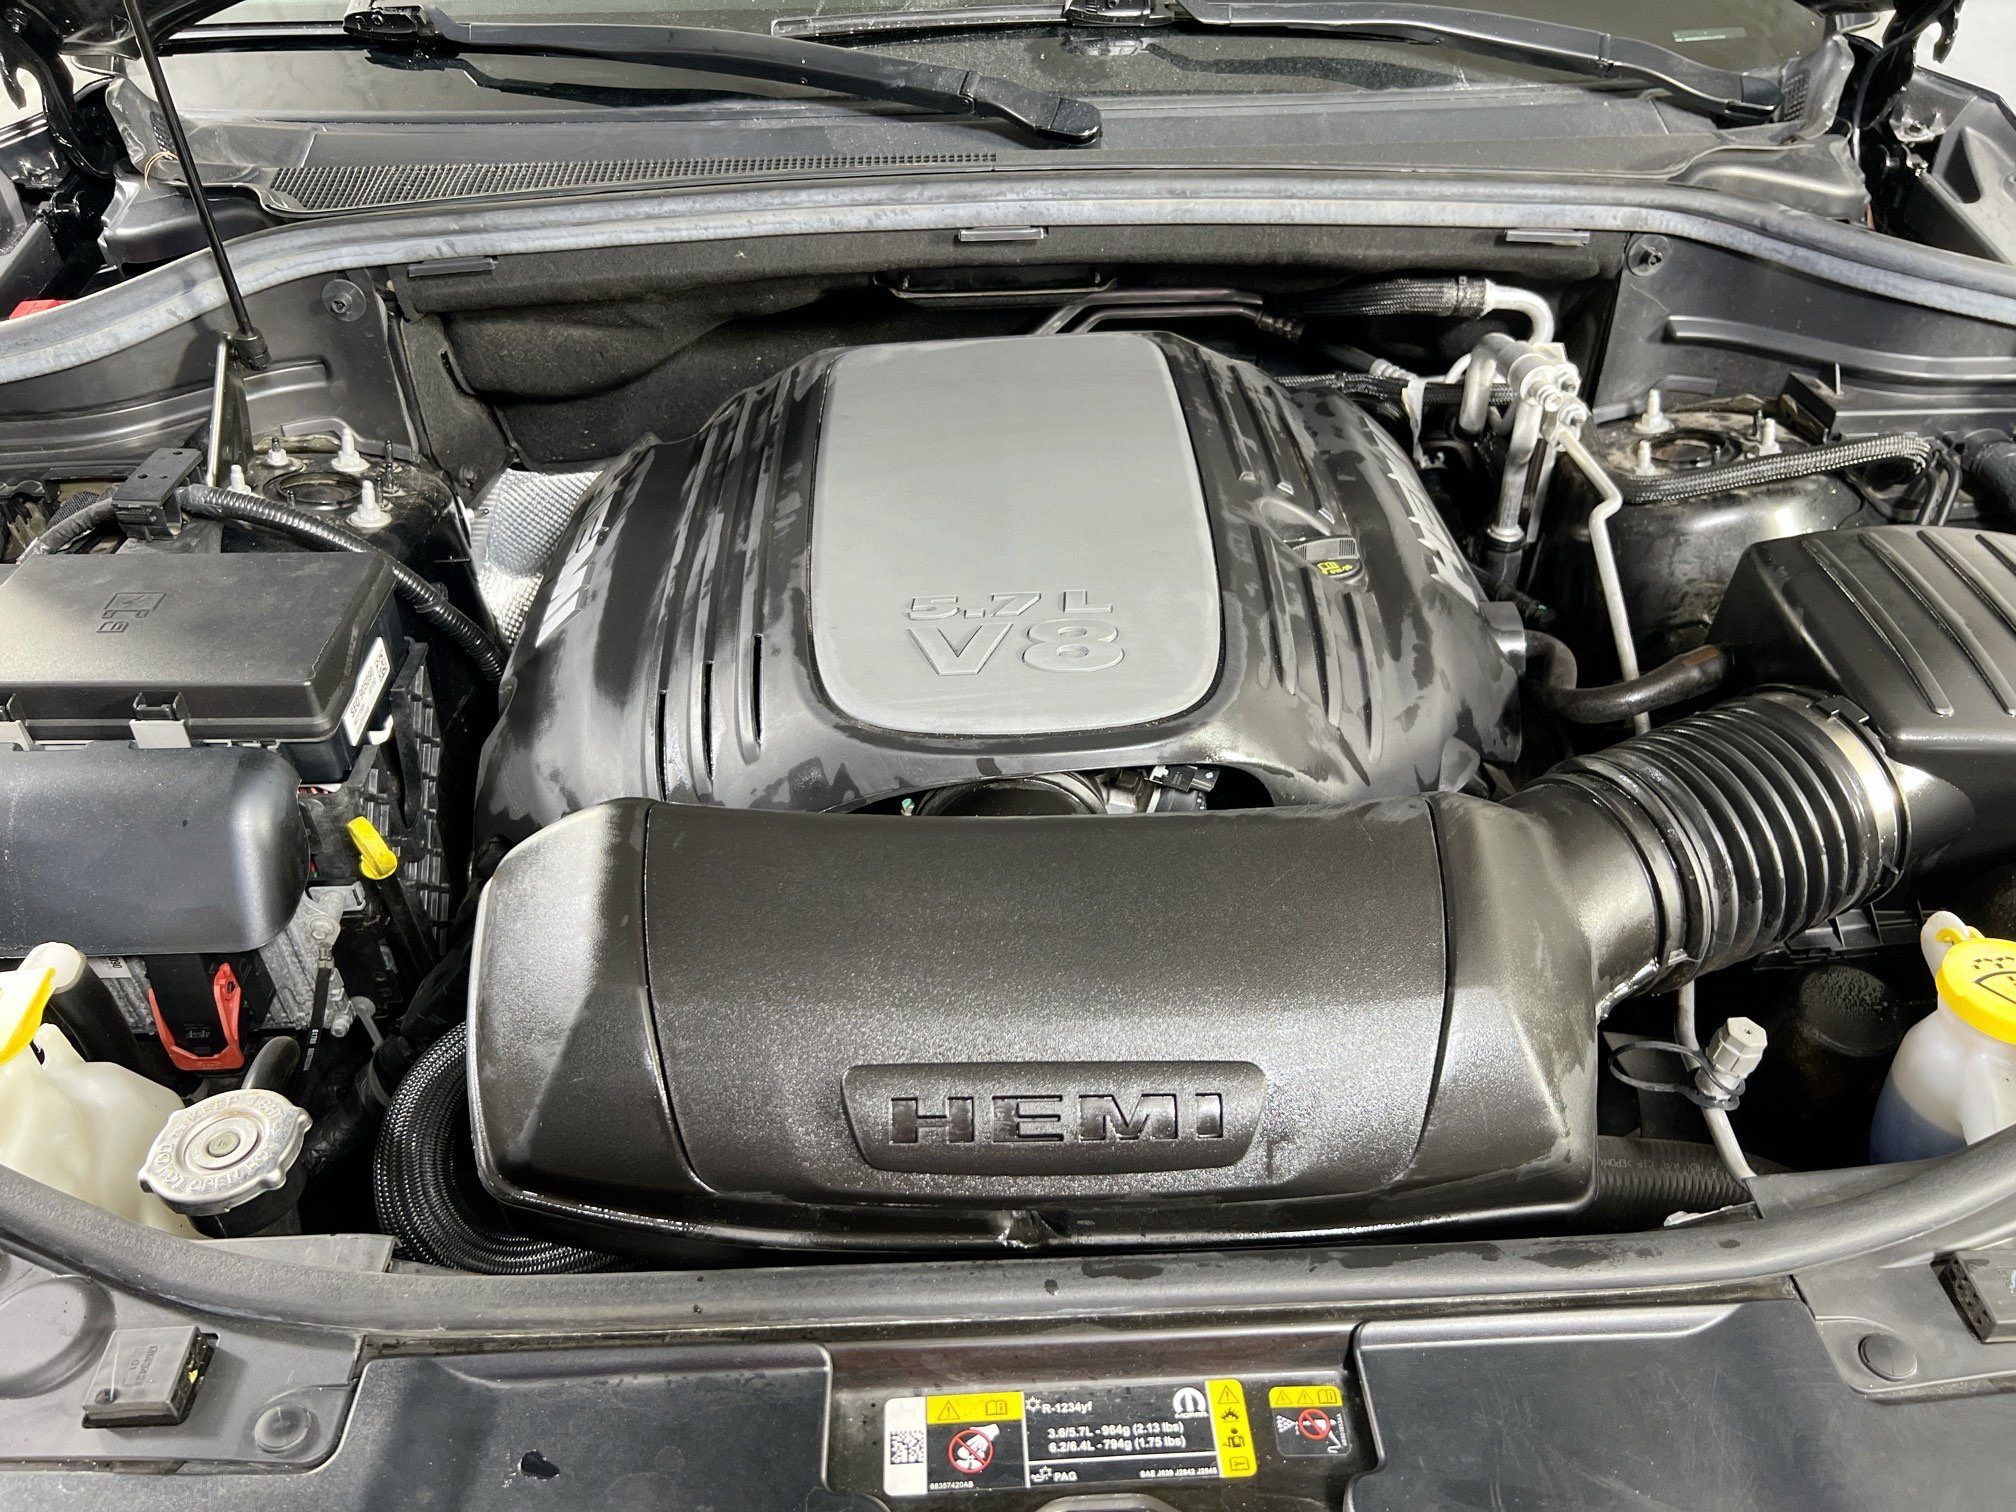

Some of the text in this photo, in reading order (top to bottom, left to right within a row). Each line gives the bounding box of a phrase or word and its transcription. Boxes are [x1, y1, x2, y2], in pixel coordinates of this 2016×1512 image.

[905, 619, 1126, 676] V8
[188, 1096, 240, 1121] KEEP
[890, 1092, 1223, 1144] HEMI
[1041, 1401, 1093, 1414] R-1234yf
[1047, 1426, 1094, 1439] 3.6/5.7L
[1101, 1424, 1131, 1437] 964g
[1132, 1422, 1160, 1436] (2.13
[1161, 1421, 1184, 1434] lbs)
[1048, 1440, 1096, 1453] 6.2/6.4L
[1103, 1438, 1132, 1452] 794g
[1134, 1436, 1162, 1451] (1.75
[1163, 1435, 1186, 1448] lbs)
[1053, 1471, 1078, 1482] PAG
[1139, 1469, 1156, 1478] SAE
